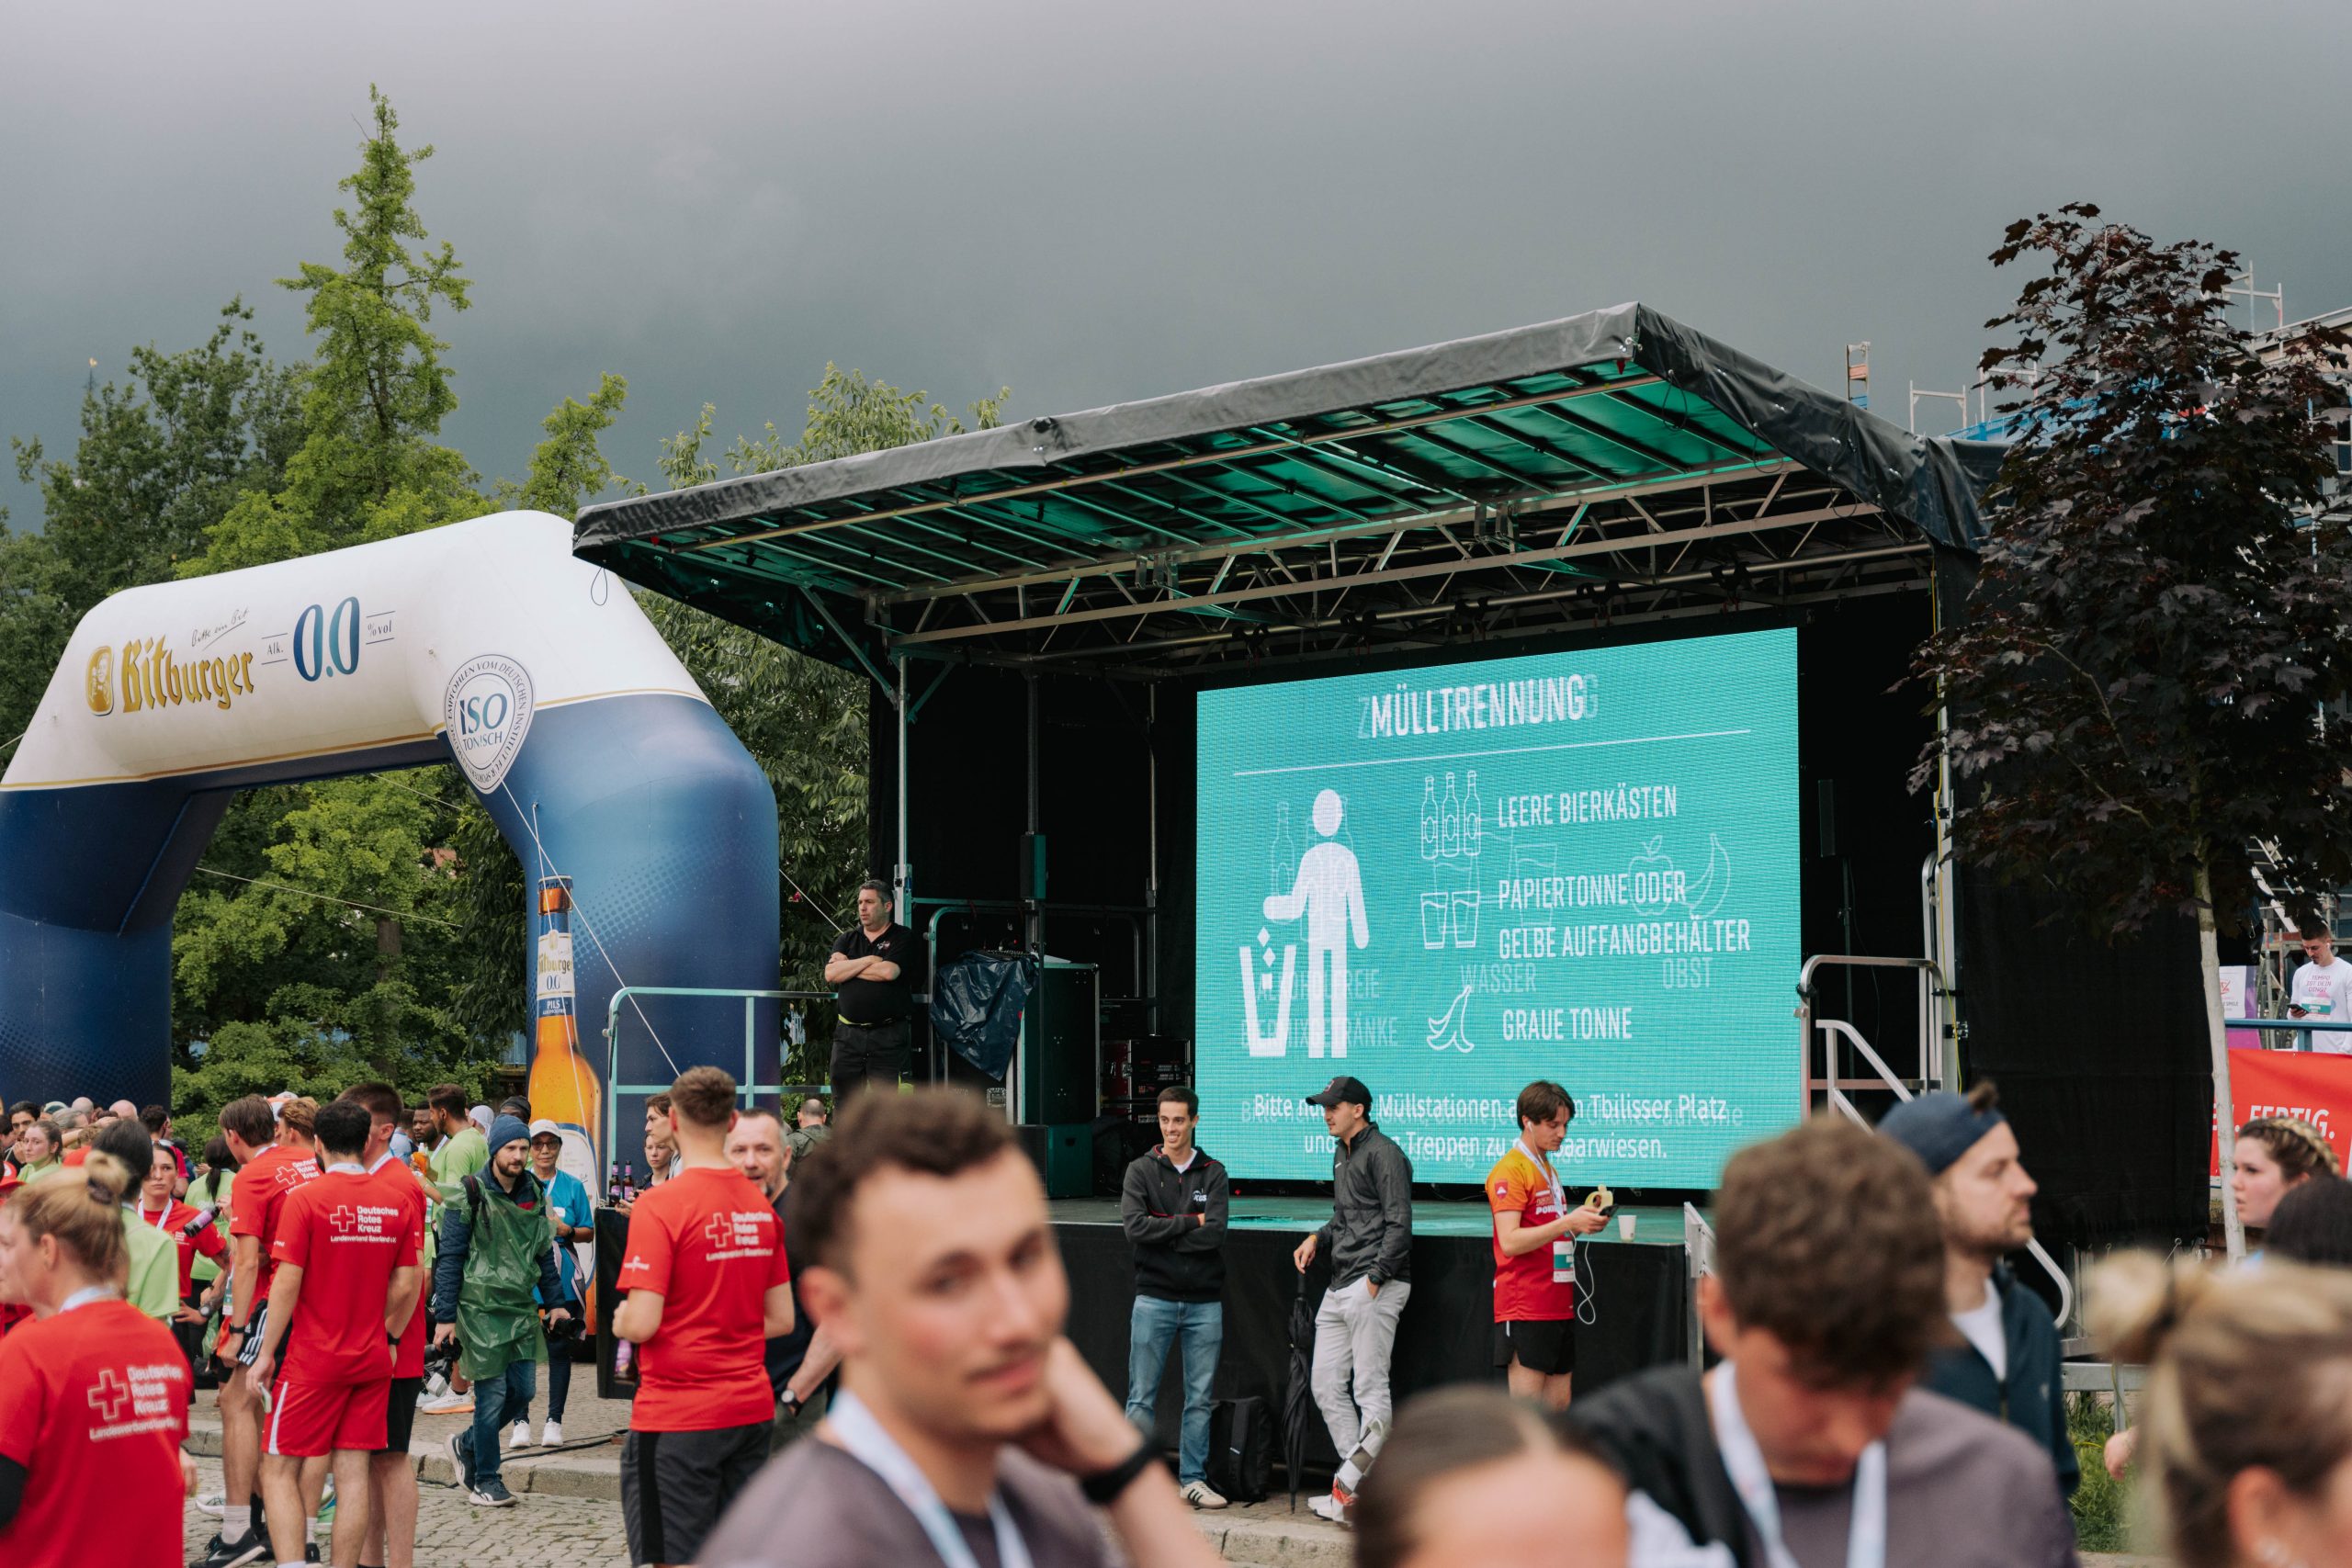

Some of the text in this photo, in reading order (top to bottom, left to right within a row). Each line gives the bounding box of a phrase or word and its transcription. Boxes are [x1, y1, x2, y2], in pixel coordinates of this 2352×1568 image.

[266, 642, 285, 656] Alk.
[293, 596, 360, 682] 0.0
[122, 634, 254, 714] Bitburger
[477, 660, 498, 671] VOM
[499, 662, 527, 710] DEUTSCHEN
[1371, 674, 1585, 739] MÜLLTRENNUNG
[1498, 783, 1678, 828] LEERE BIERKÄSTEN
[1499, 870, 1687, 910] PAPIERTONNE ODER
[1498, 915, 1751, 959] GELBE AUFFANGBEHÄLTER
[1460, 962, 1537, 994] WASSER
[1662, 956, 1713, 989] OBST
[547, 1000, 560, 1010] PILS
[1502, 1007, 1634, 1042] GRAUE TONNE
[1254, 1092, 1294, 1118] Bitte
[1378, 1092, 1501, 1119] Müllstationen
[1589, 1092, 1673, 1120] Tbilisser
[1678, 1092, 1727, 1120] Platz
[1405, 1131, 1480, 1163] Treppen
[1485, 1136, 1507, 1156] zu
[356, 1205, 399, 1217] Deutsches
[357, 1214, 382, 1224] Rotes
[357, 1224, 382, 1233] Kreuz
